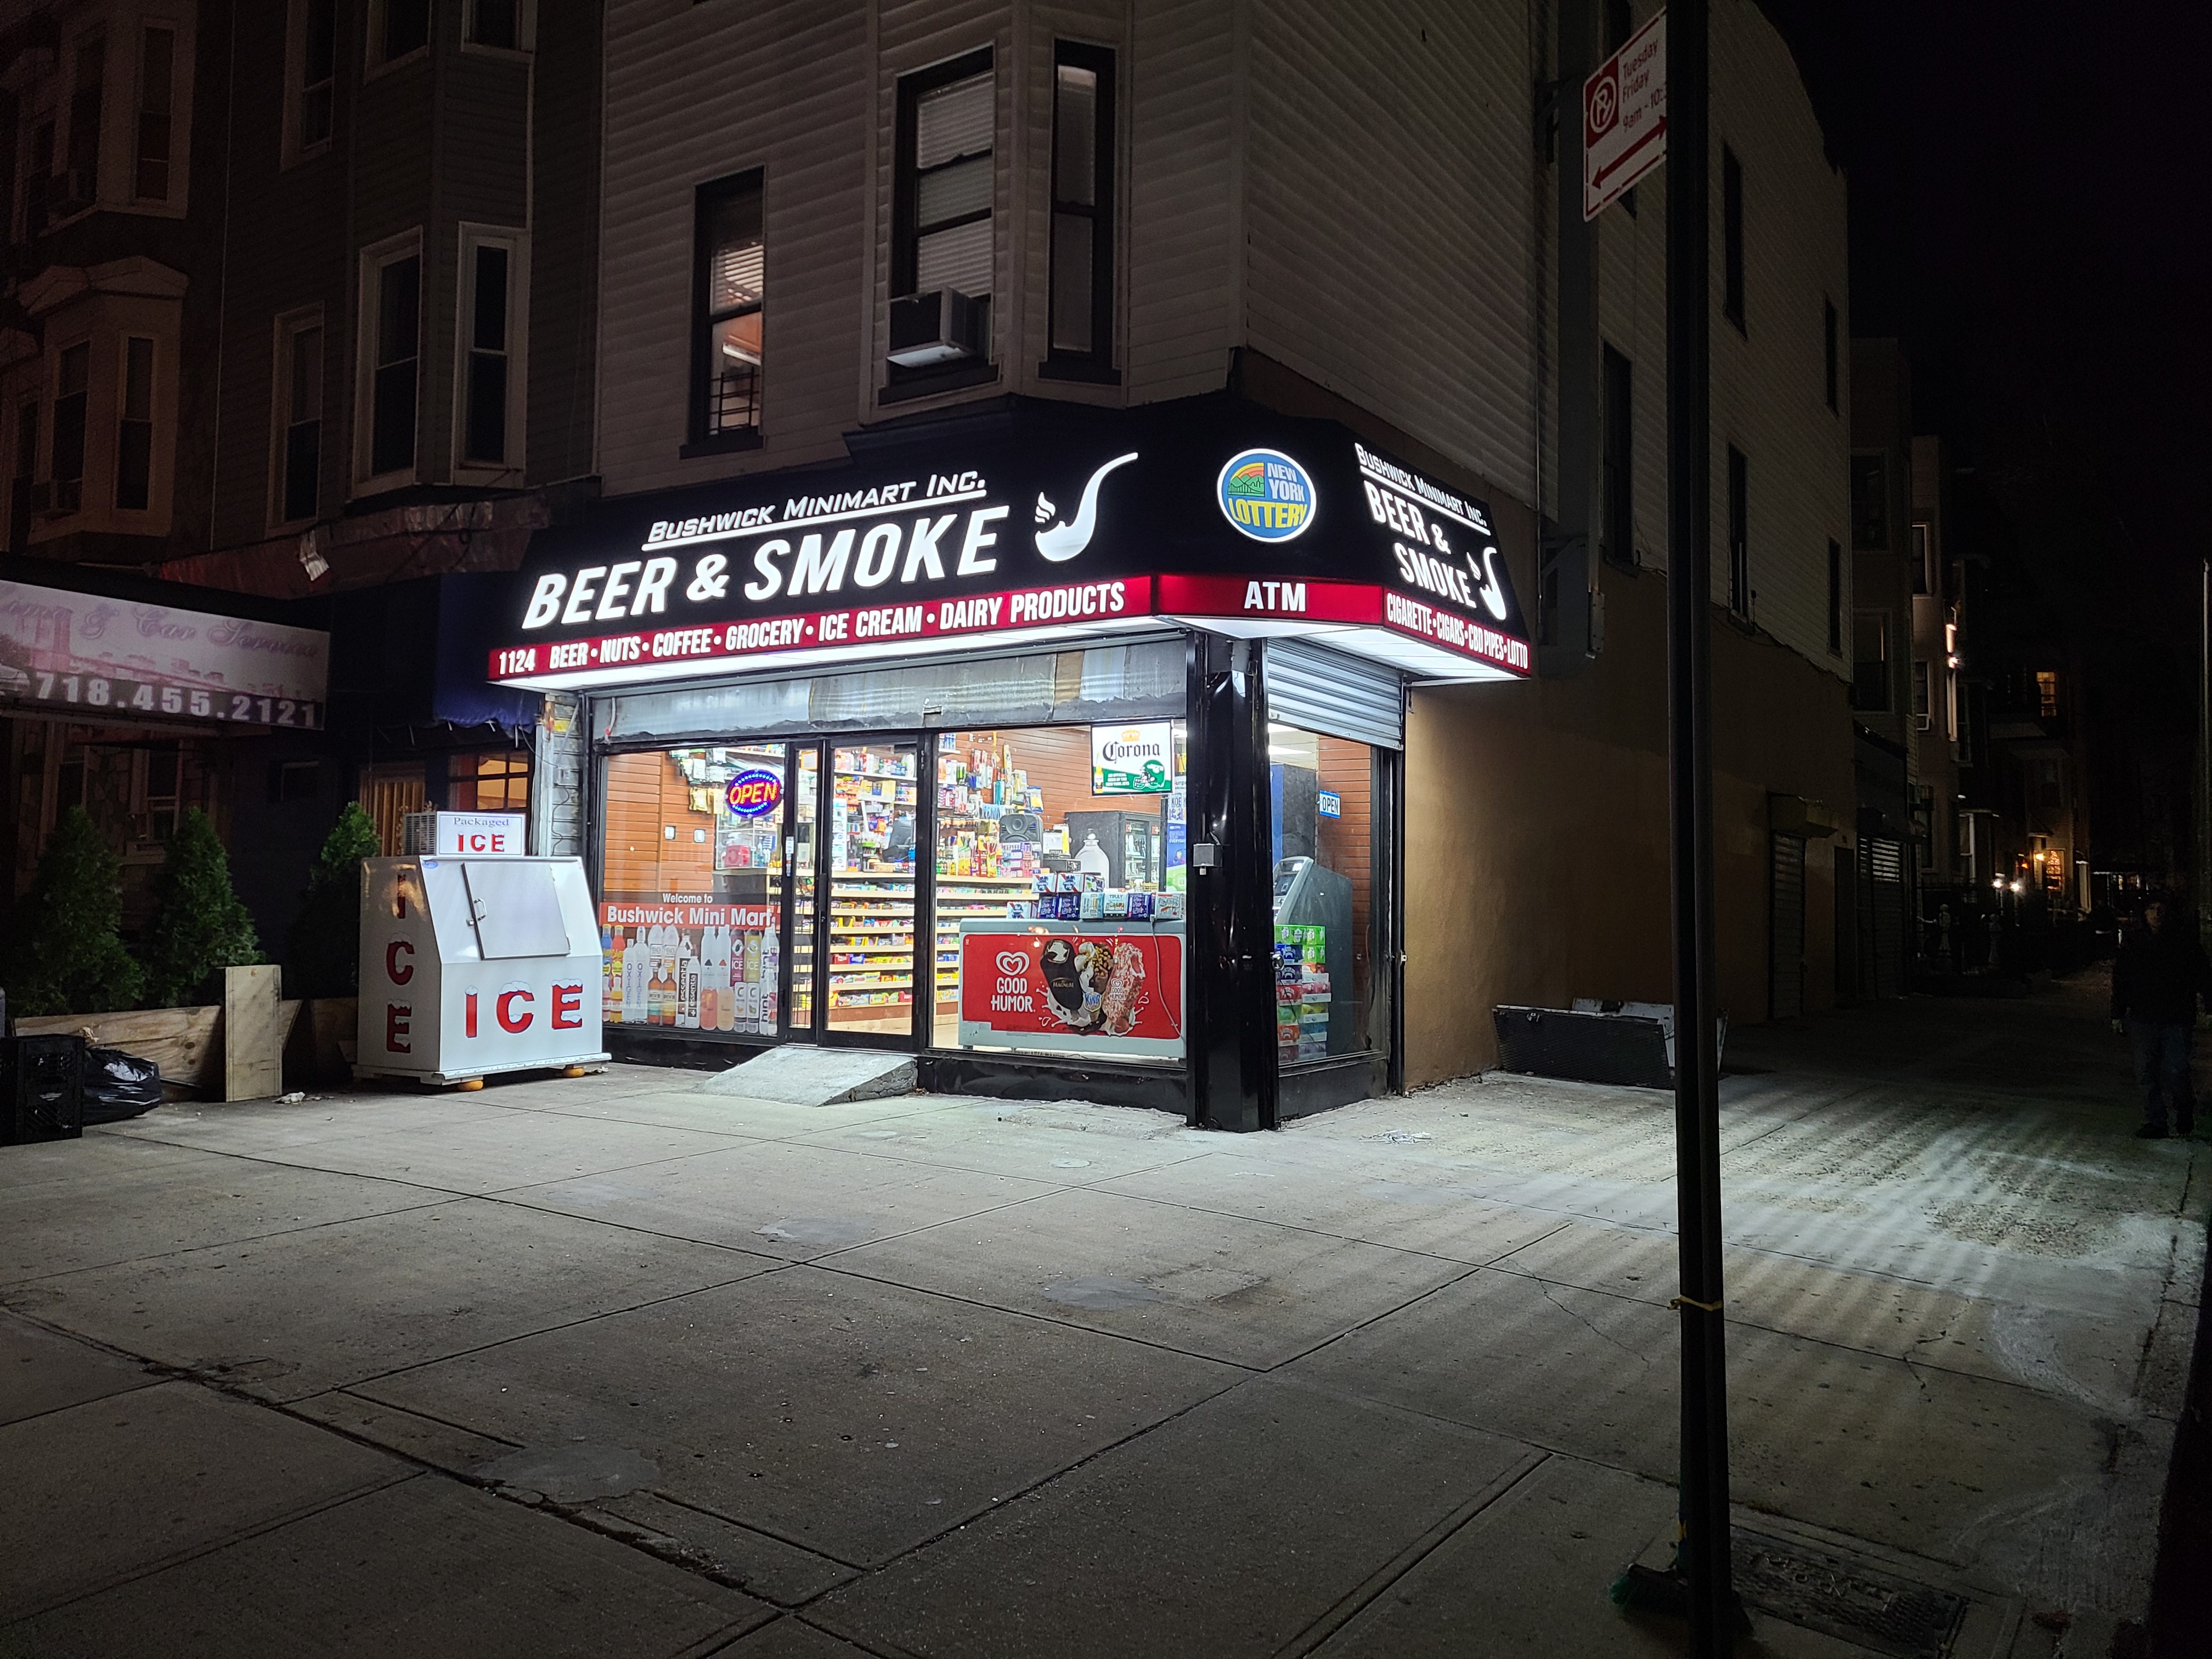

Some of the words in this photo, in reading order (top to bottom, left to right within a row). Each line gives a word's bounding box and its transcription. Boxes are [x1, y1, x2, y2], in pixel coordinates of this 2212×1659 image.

[1623, 38, 1658, 80] Tuesday
[1622, 70, 1649, 104] Friday
[1623, 108, 1641, 133] 9am
[1268, 462, 1297, 481] NEW
[1269, 478, 1305, 502] YORK
[1228, 498, 1307, 528] LOTTERY
[1363, 480, 1430, 546] BEER
[1431, 523, 1452, 554] &
[521, 556, 677, 629] BEER
[686, 553, 730, 602] &
[744, 505, 1009, 601] SMOKE
[1392, 541, 1477, 608] SMOKE
[1244, 580, 1306, 612] ATM
[131, 604, 196, 639] Car
[499, 648, 535, 675] 1124
[549, 642, 589, 669] BEER
[600, 635, 641, 663] NUTS
[652, 628, 713, 658] COFFEE
[725, 618, 805, 651] GROCERY
[818, 613, 849, 641] ICE
[855, 605, 923, 637] CREAM
[939, 597, 1003, 630] DAIRY
[1009, 581, 1125, 623] PRODUCTS
[1386, 591, 1433, 637] CIGARETTE
[1436, 612, 1465, 647] CIGARS
[1468, 627, 1483, 652] CBD
[1484, 630, 1505, 662] PIPES
[1506, 640, 1528, 670] LOTTO
[35, 672, 316, 727] 718.455.2121
[1102, 740, 1160, 764] Corona
[729, 782, 778, 805] OPEN
[1322, 797, 1339, 814] OPEN
[453, 816, 509, 828] Packaged
[458, 833, 505, 852] ICE
[663, 893, 702, 904] Welcome
[704, 893, 713, 904] to
[607, 906, 684, 924] Bushwick
[689, 907, 725, 925] Mini
[731, 908, 772, 926] Mart
[732, 961, 743, 969] ICE
[747, 961, 759, 970] ICE
[996, 977, 1028, 994] GOOD
[465, 979, 583, 1039] ICE
[991, 995, 1033, 1013] HUMOR
[1085, 994, 1101, 1005] KING
